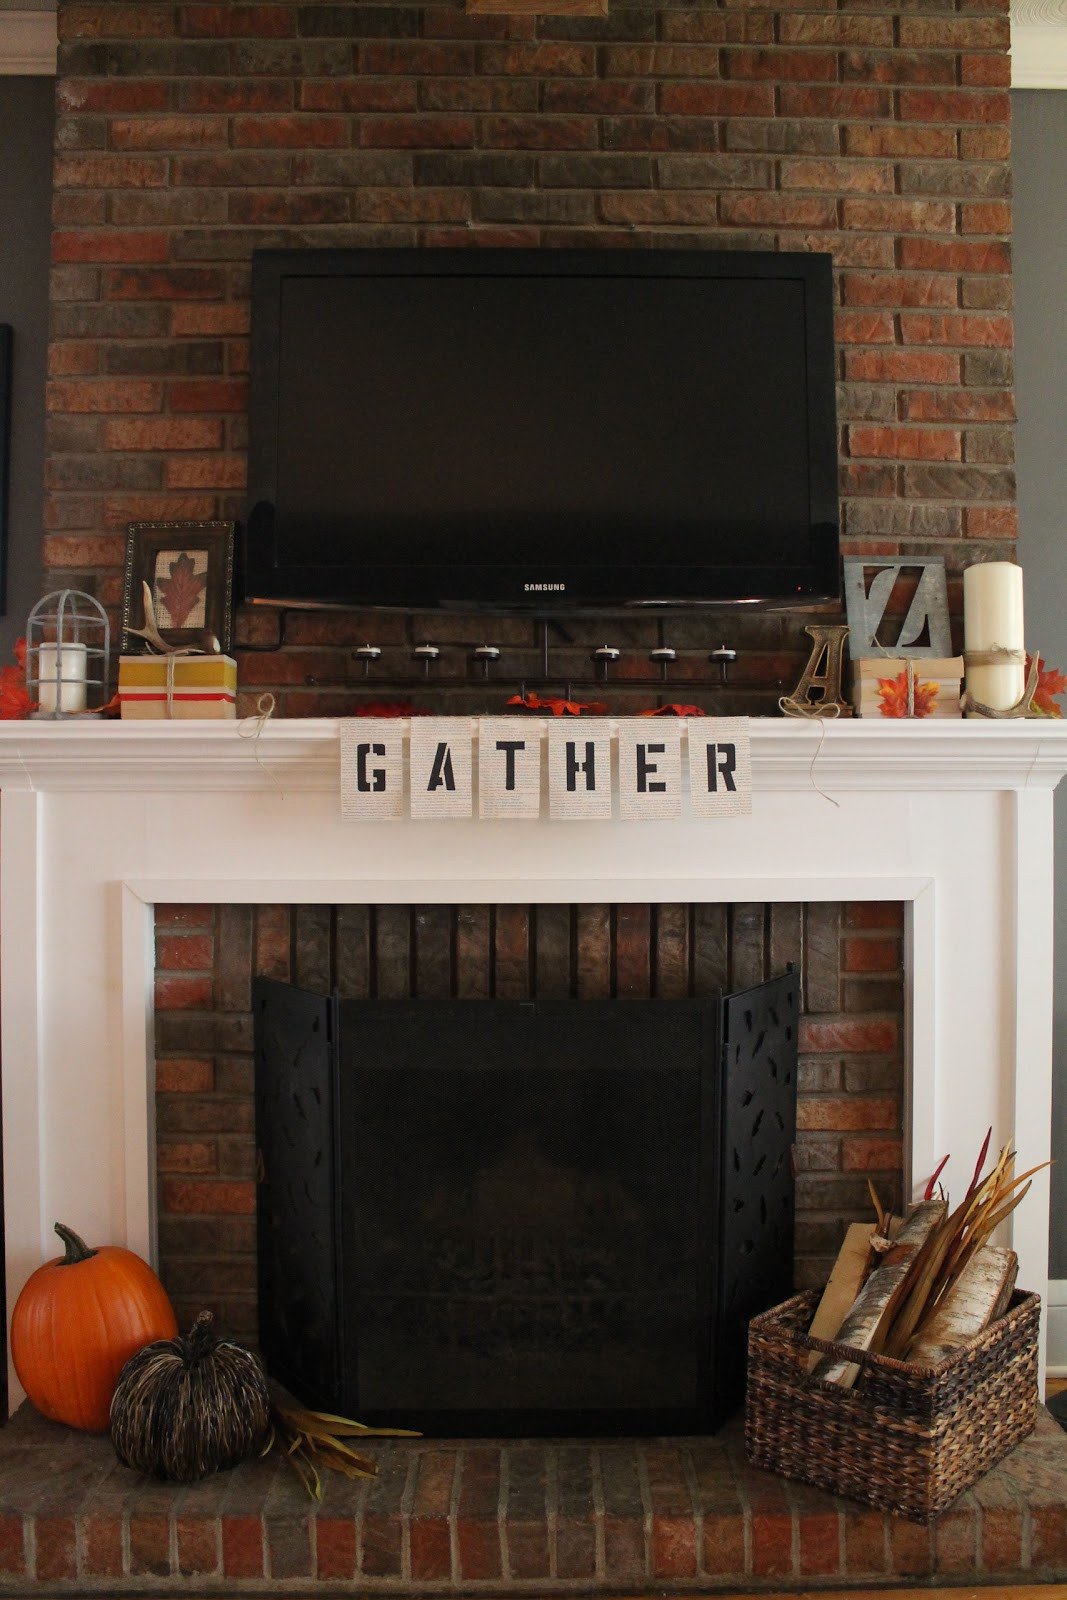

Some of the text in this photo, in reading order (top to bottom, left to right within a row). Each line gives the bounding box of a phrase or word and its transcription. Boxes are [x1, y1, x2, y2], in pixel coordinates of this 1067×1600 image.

[524, 583, 566, 591] SAMSUNG
[862, 565, 932, 648] Z
[784, 626, 850, 706] A
[356, 741, 737, 793] GATHER
